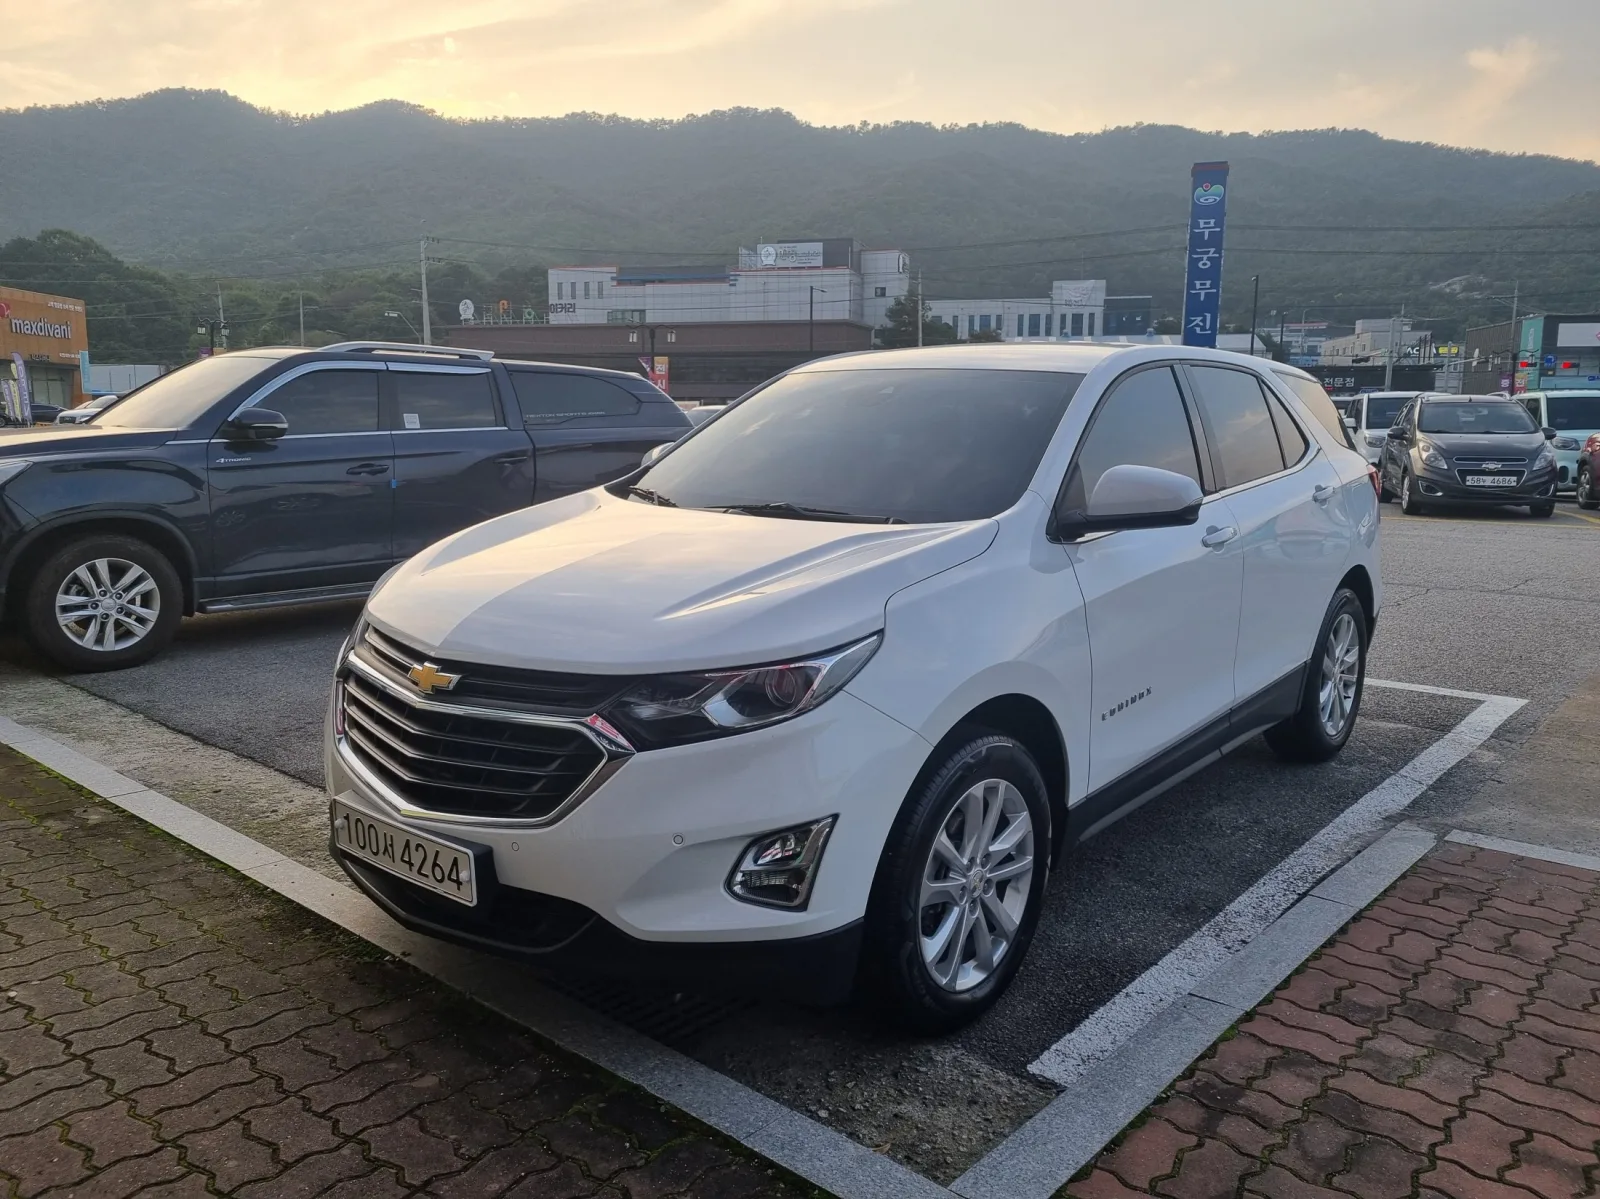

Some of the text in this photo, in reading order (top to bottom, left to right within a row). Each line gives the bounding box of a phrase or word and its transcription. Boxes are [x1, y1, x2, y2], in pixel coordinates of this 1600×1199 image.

[1187, 218, 1221, 334] 무궁무진
[11, 317, 71, 339] maxdivani
[1323, 377, 1355, 388] 전문점
[1490, 477, 1513, 485] 4686
